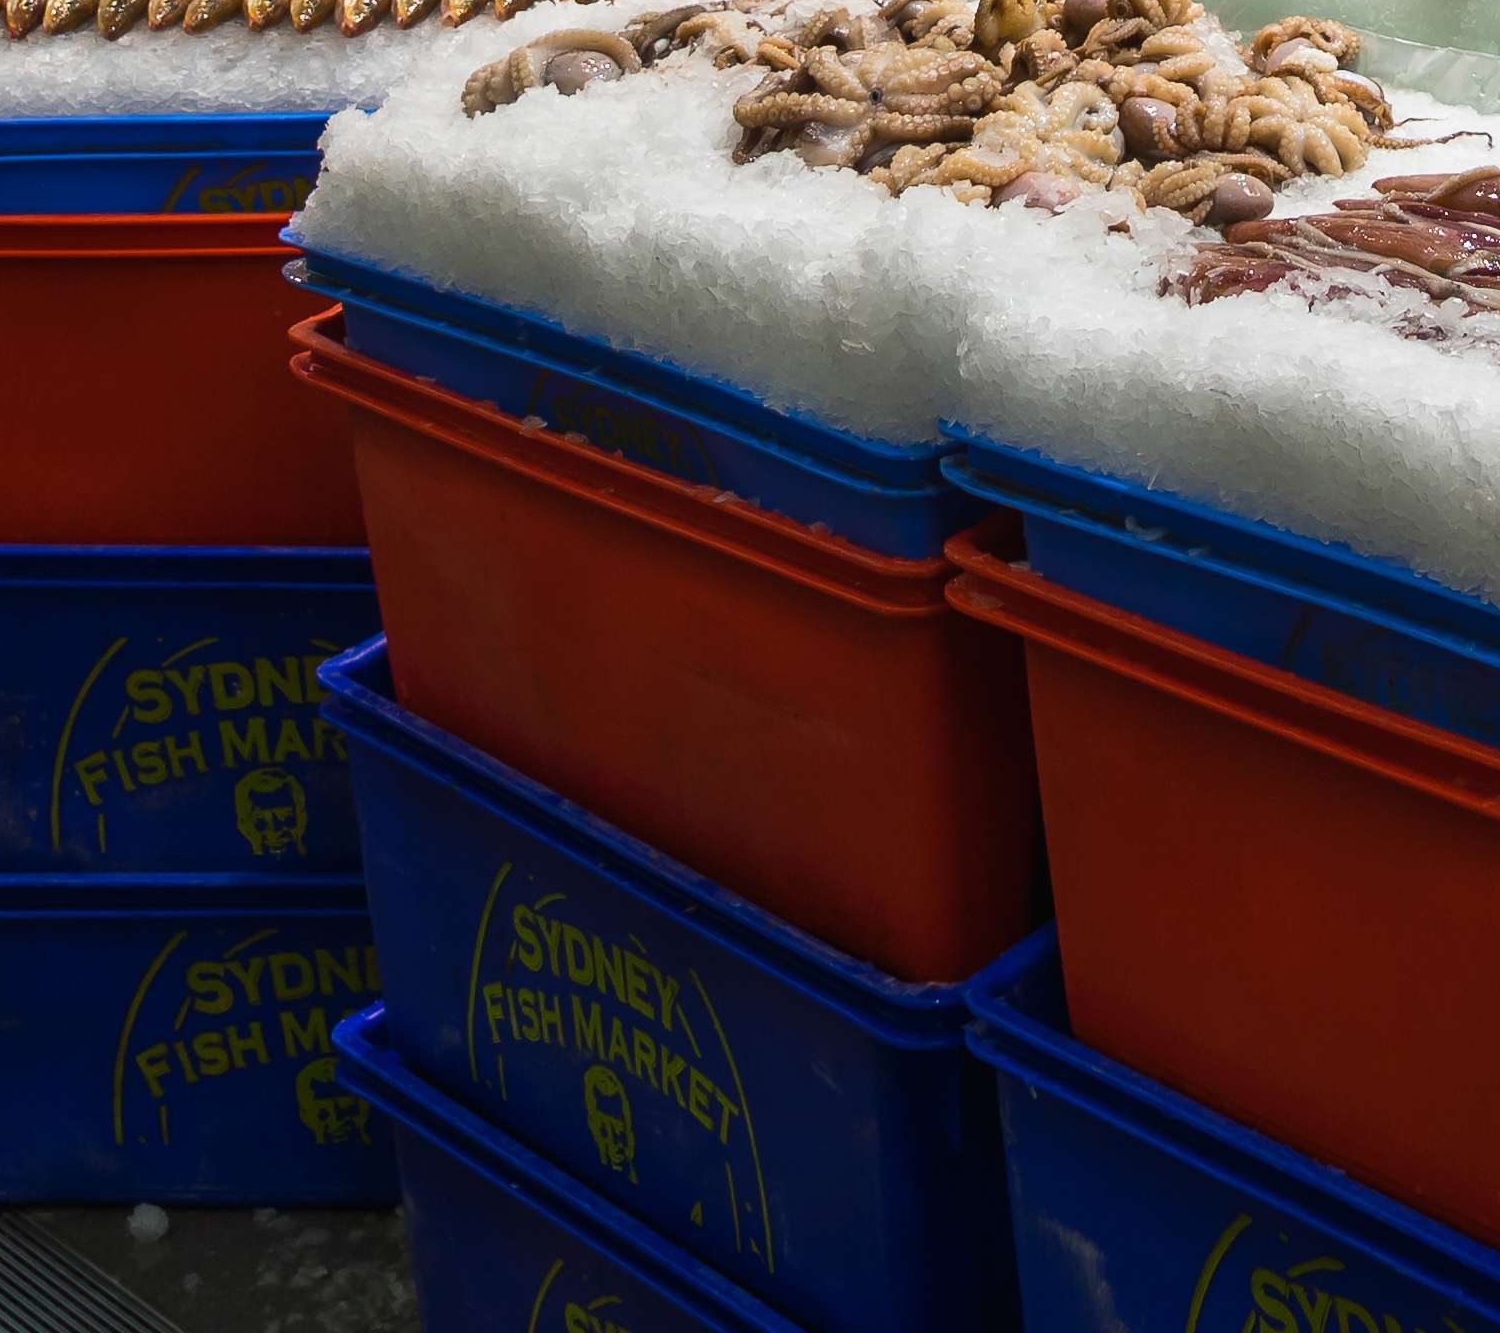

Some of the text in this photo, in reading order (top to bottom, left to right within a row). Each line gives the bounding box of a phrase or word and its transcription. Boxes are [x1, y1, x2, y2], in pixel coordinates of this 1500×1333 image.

[125, 656, 332, 724] SYDNE
[74, 730, 209, 806] FISH
[512, 904, 680, 1031] SYDNEY
[136, 1021, 271, 1098] FISH
[483, 981, 739, 1145] FISH MARKET
